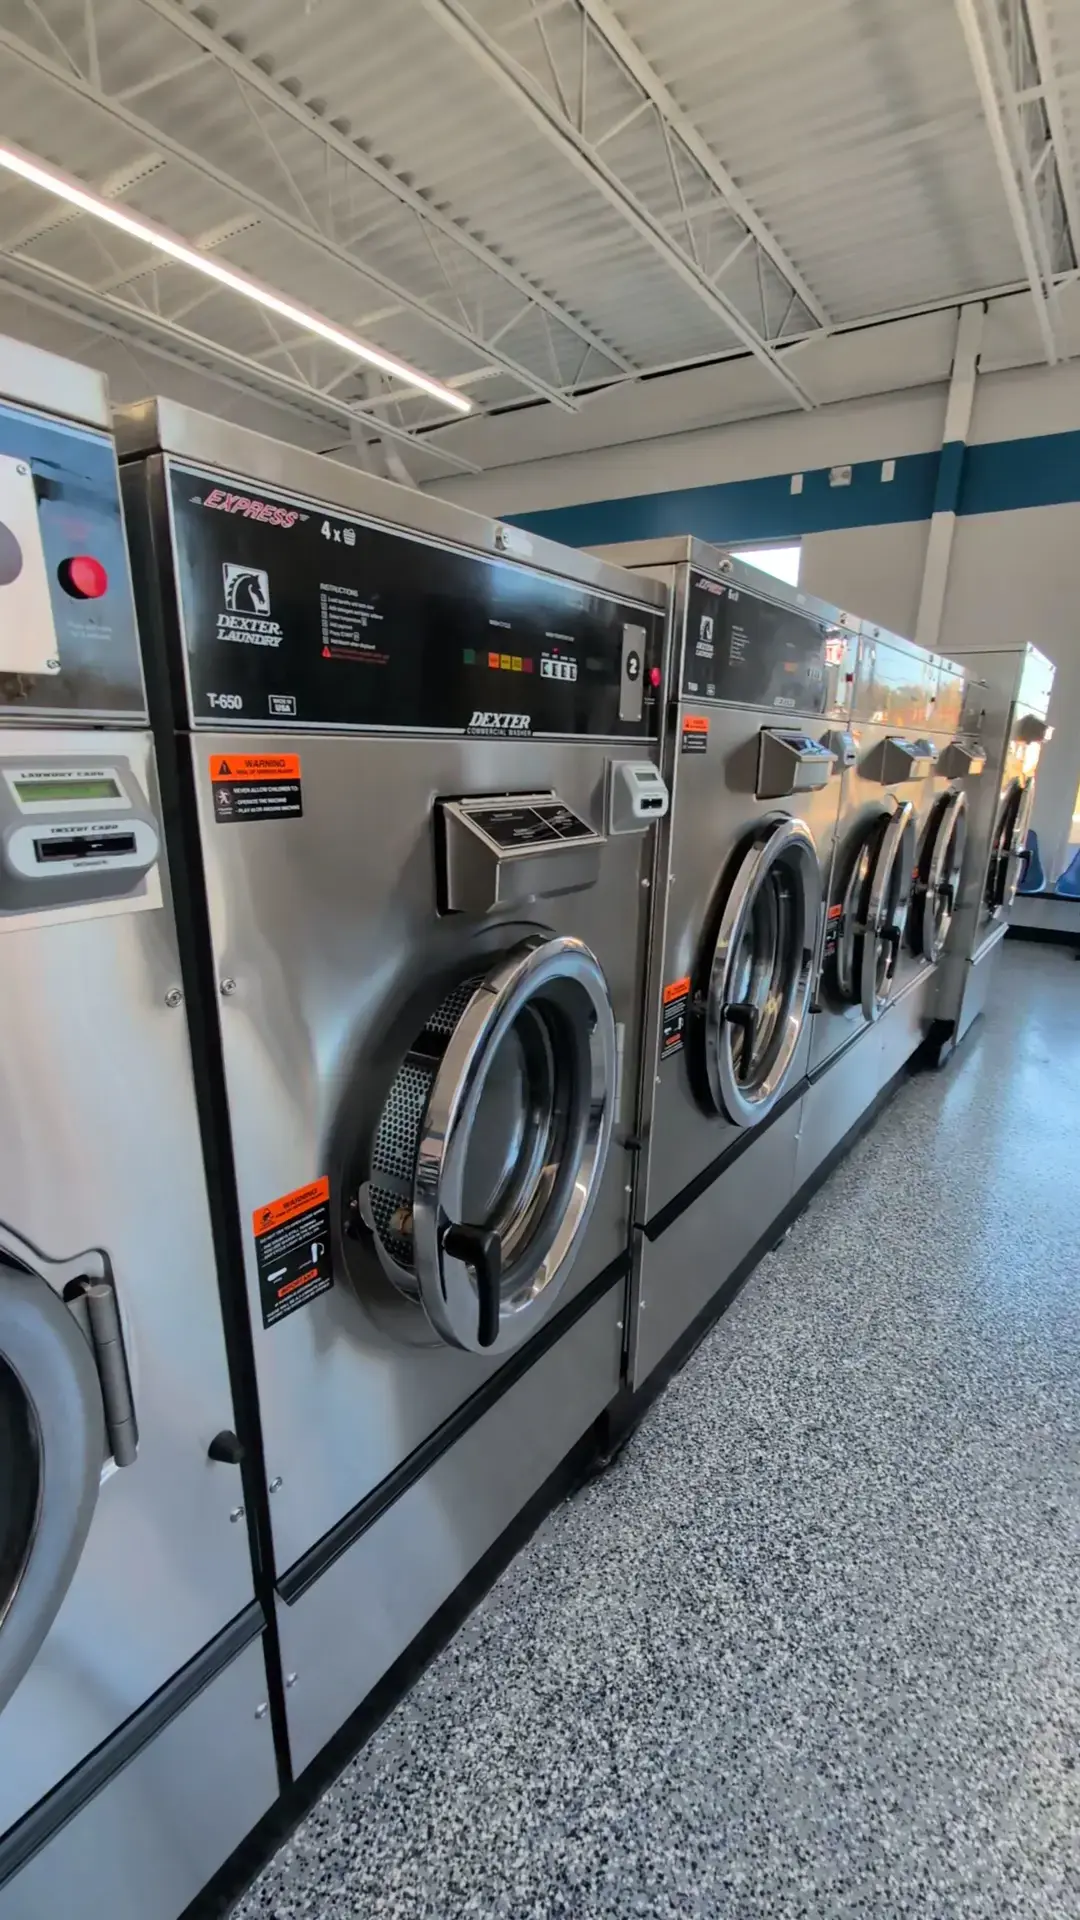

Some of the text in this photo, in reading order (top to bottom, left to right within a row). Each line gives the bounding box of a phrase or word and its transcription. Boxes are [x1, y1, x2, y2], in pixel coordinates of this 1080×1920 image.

[203, 489, 299, 529] EXPRESS
[216, 629, 283, 647] LAUNDRY
[629, 658, 637, 674] 2
[206, 692, 242, 710] T-650
[468, 711, 531, 729] DEXTER
[466, 727, 507, 736] COMMERCIAL
[244, 759, 286, 768] WARNING
